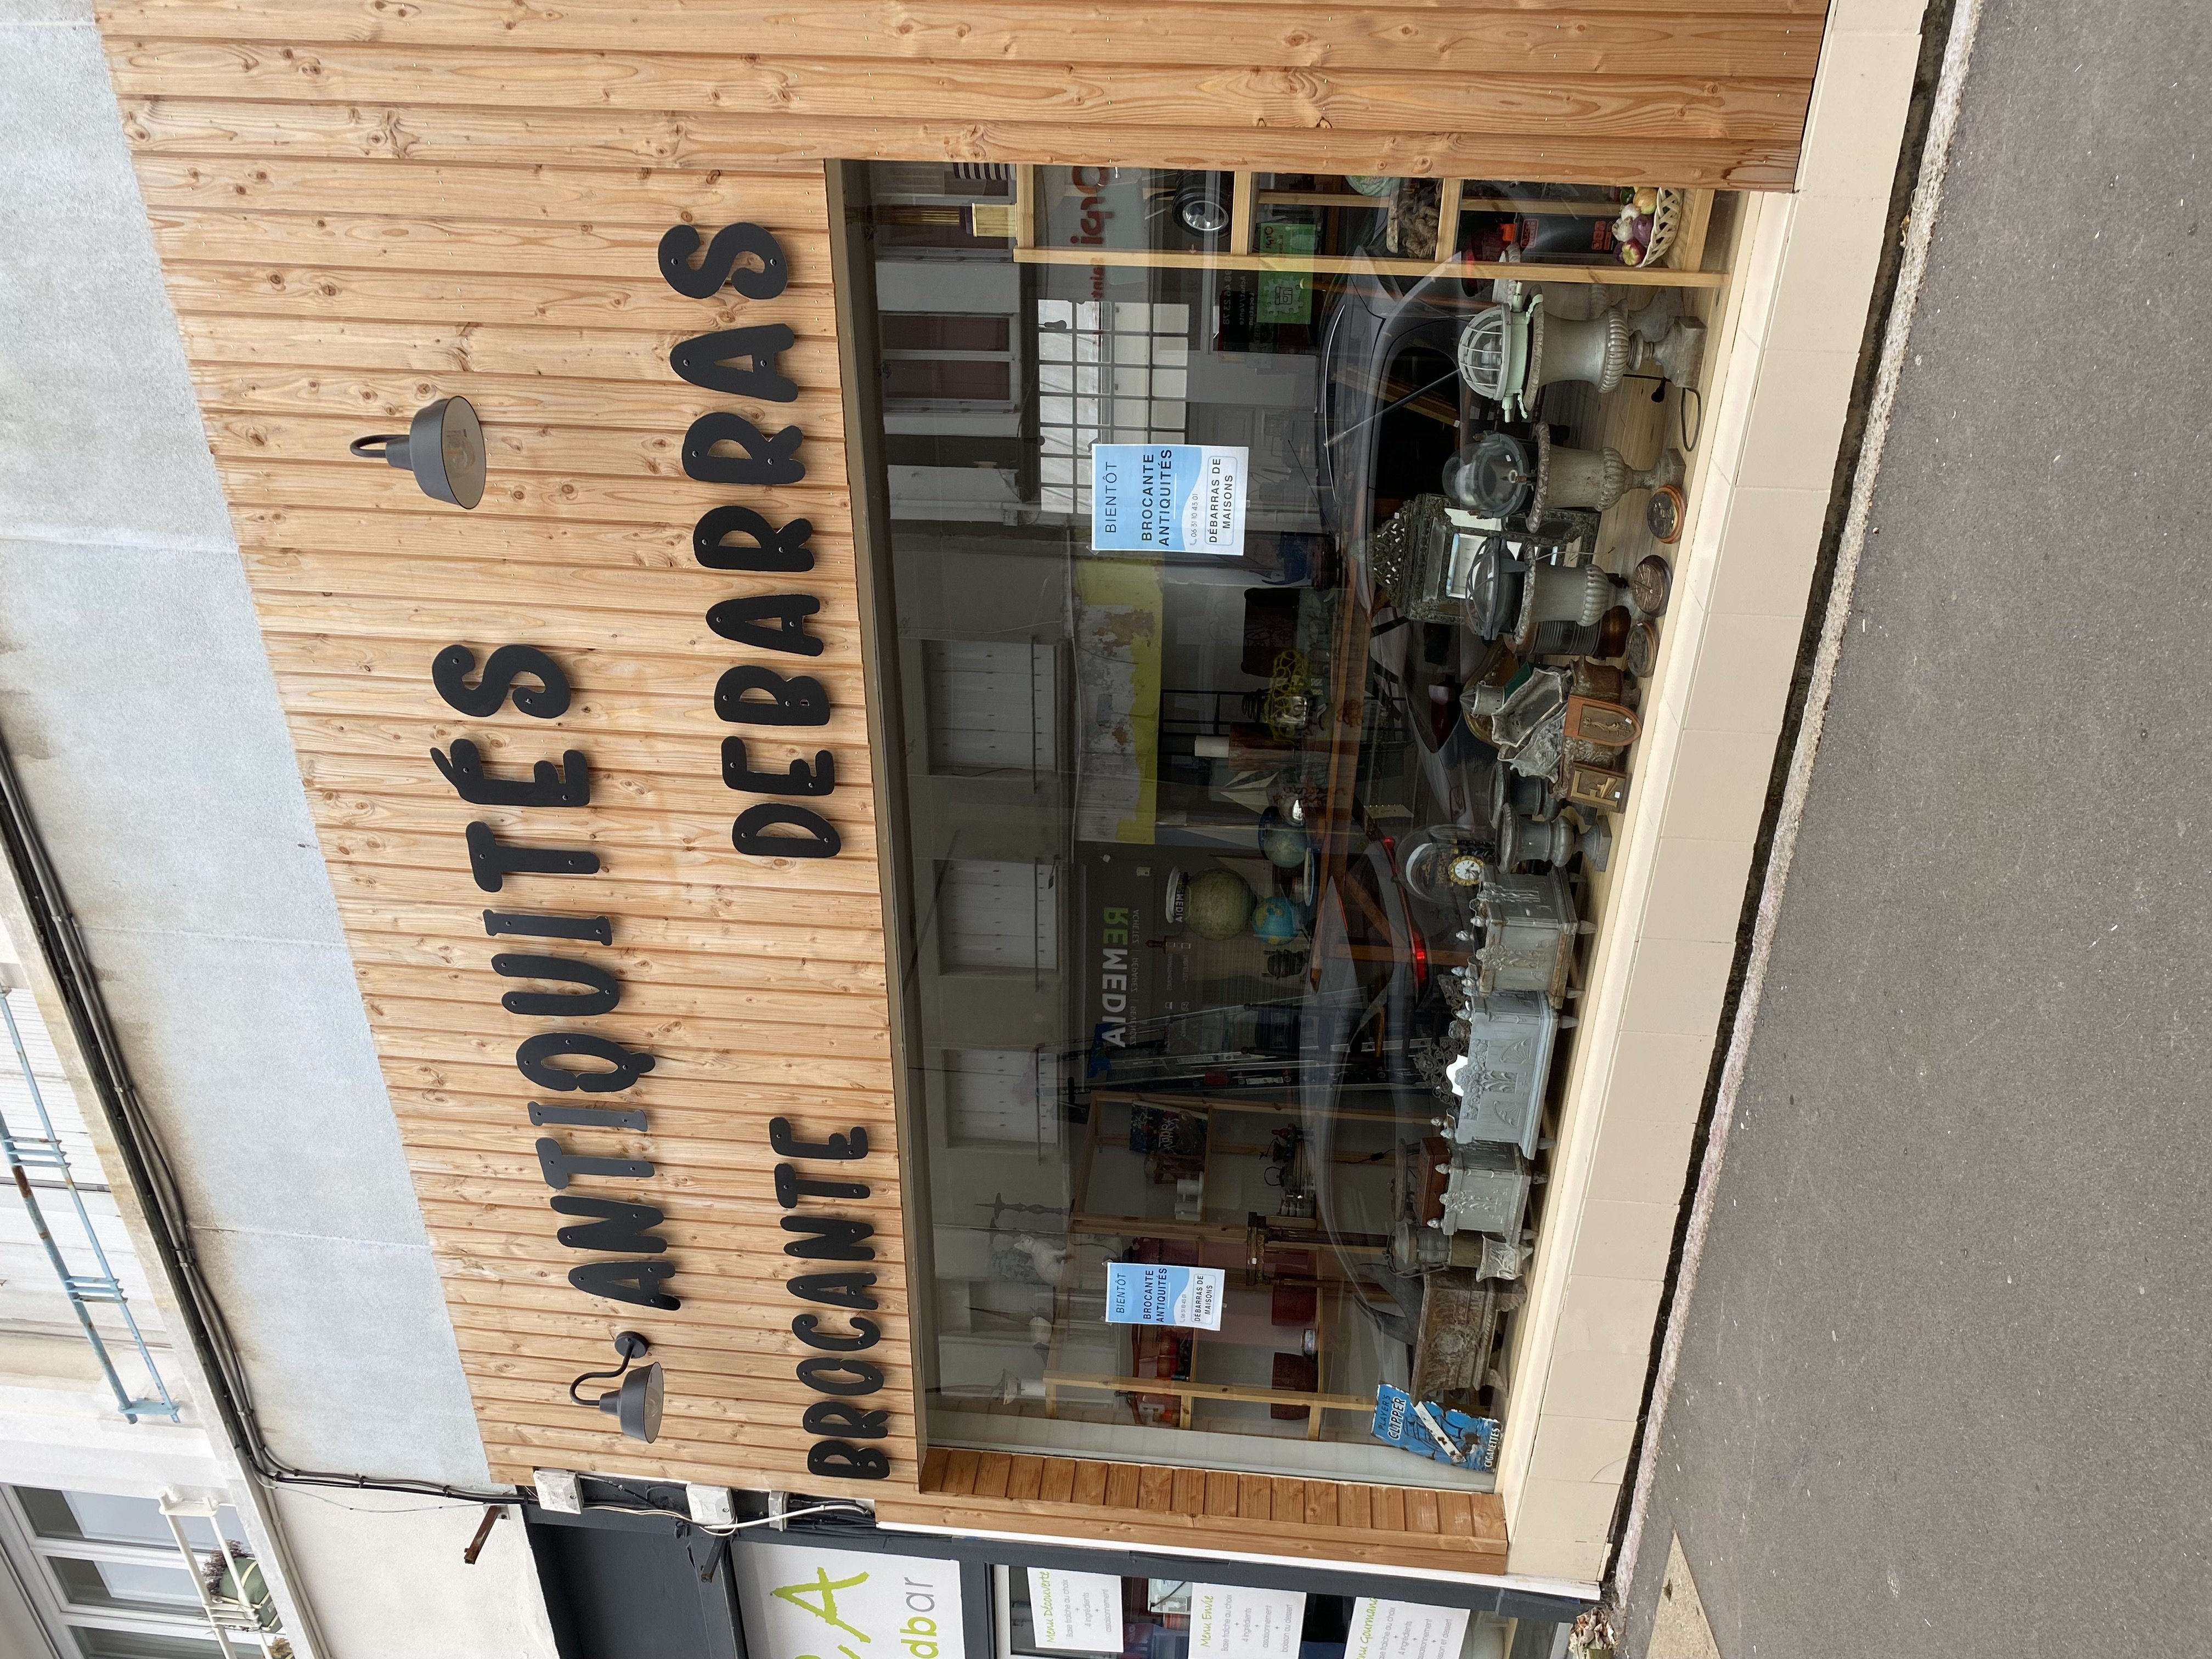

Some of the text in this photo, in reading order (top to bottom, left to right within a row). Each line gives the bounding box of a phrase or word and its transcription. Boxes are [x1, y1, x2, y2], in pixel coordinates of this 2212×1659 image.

[1103, 461, 1117, 533] BIENTÔT
[1141, 454, 1154, 541] BROCANTE
[1158, 449, 1172, 546] ANTIQUITÉS
[1192, 502, 1198, 511] 43
[1207, 458, 1221, 543] DÉBARRAS DE
[1222, 475, 1233, 529] MAISONS
[658, 222, 841, 859] DEBARRAS
[1190, 529, 1197, 537] 06
[430, 644, 681, 1311] ANTIQUITÉS
[769, 1116, 890, 1479] BROCANTE
[1115, 1273, 1126, 1313] BIENTÔT
[1143, 1270, 1154, 1319] BROCANTE
[1156, 1268, 1167, 1323] ANTIQUITÉS
[1193, 1275, 1203, 1322] DÉBARRAS DE
[1204, 1285, 1213, 1314] MAISONS
[1378, 1395, 1390, 1430] PLAYER'S
[1387, 1397, 1406, 1439] CLIPPER
[1040, 1571, 1056, 1642] Menu Découverte
[1200, 1595, 1214, 1647] Menu Envie
